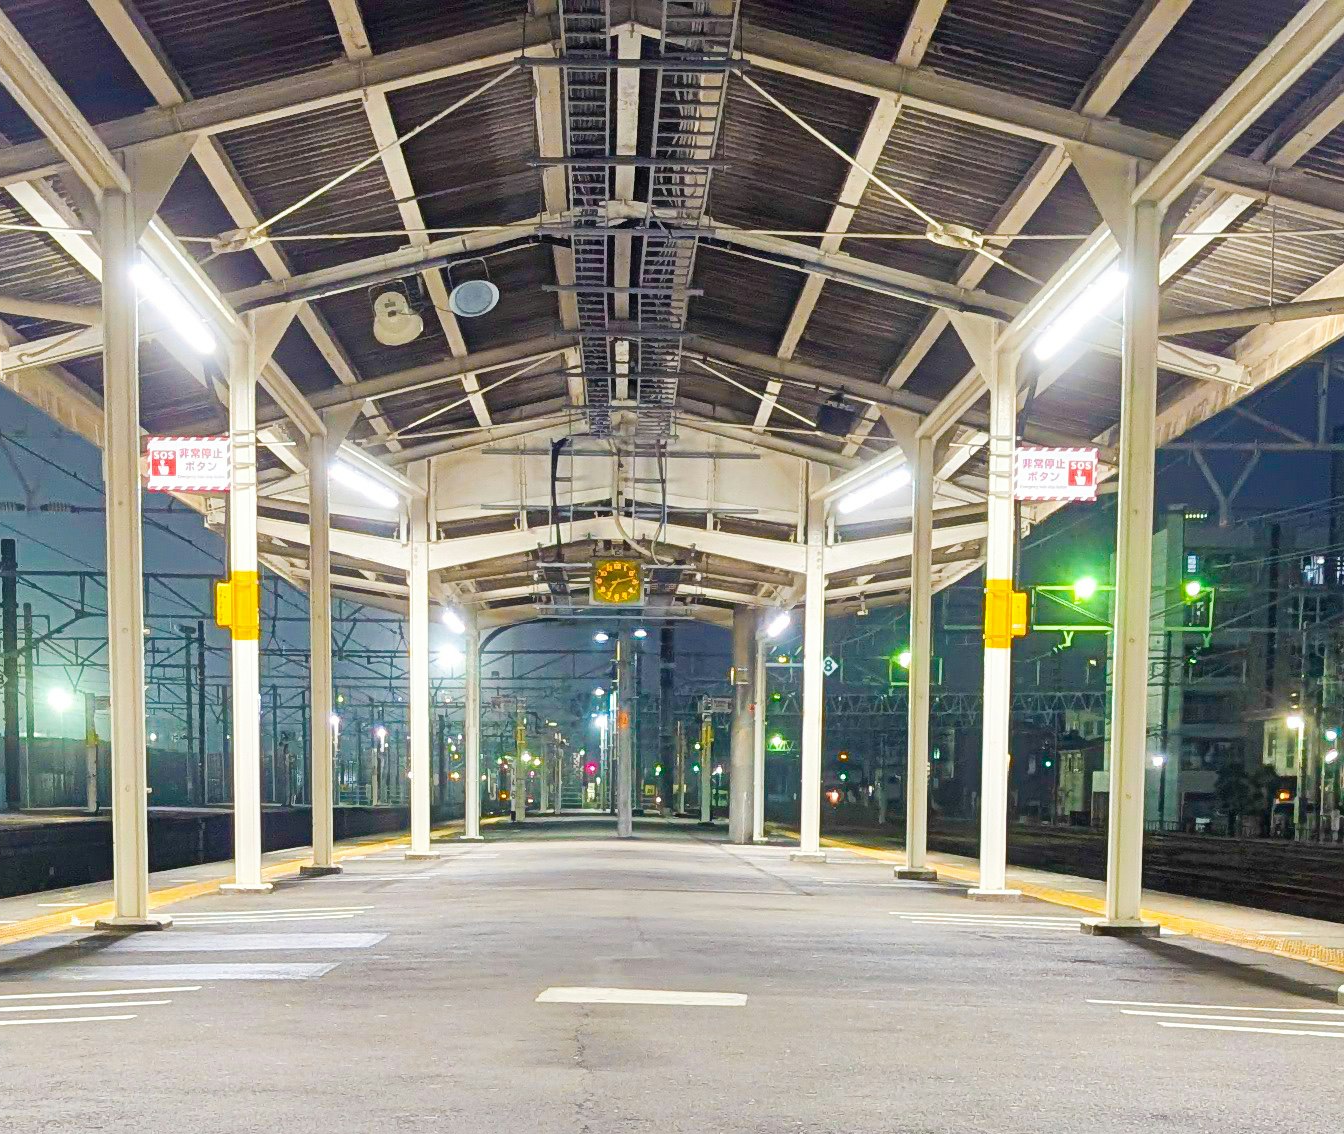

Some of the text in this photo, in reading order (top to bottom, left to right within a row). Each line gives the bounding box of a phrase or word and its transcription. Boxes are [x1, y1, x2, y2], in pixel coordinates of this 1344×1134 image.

[153, 451, 174, 460] SOS
[179, 448, 223, 459] 非常停止
[185, 461, 217, 472] ボタン
[1023, 458, 1065, 469] 非常停止
[1070, 461, 1092, 470] SOS
[1028, 471, 1060, 482] ボタン
[824, 659, 833, 672] 8
